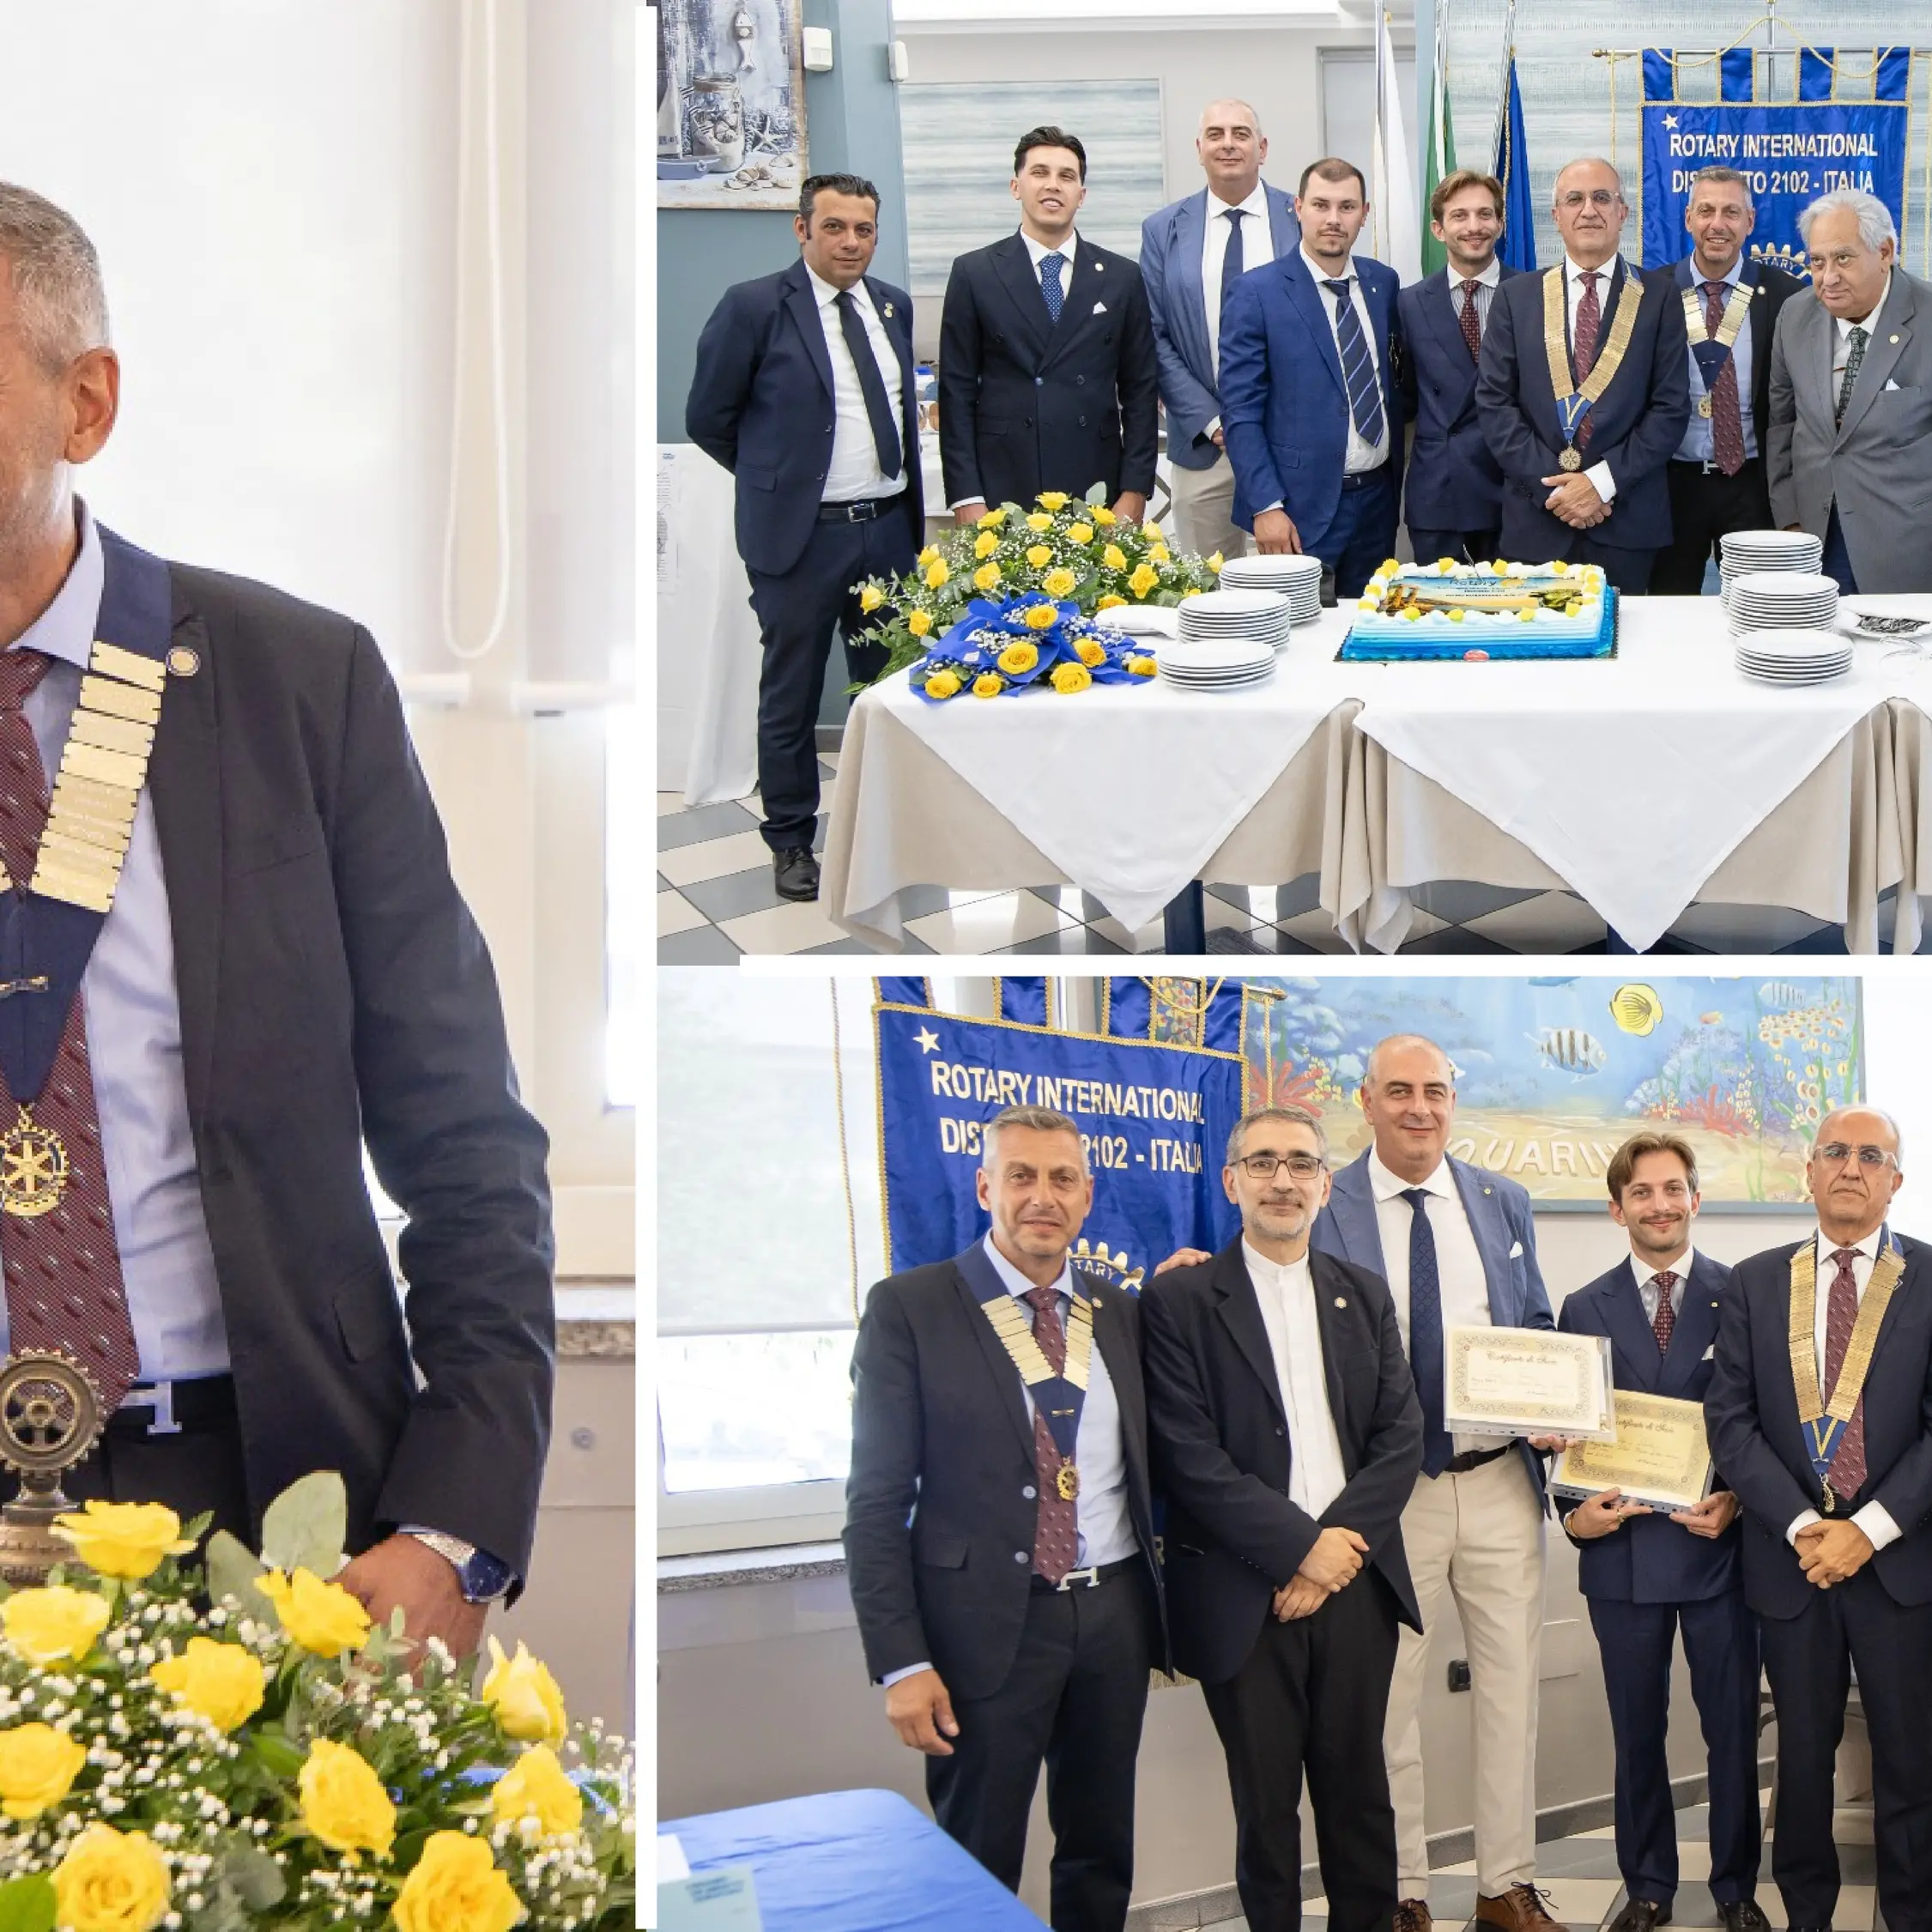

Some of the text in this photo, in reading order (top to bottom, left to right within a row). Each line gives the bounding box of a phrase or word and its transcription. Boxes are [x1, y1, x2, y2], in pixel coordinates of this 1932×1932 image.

[1670, 134, 1878, 157] ROTARY INTERNATIONAL
[1771, 171, 1808, 194] 2102
[1824, 171, 1874, 193] ITALIA
[930, 1060, 1205, 1124] ROTARY INTERNATIONAL
[1151, 1138, 1203, 1175] ITALIA
